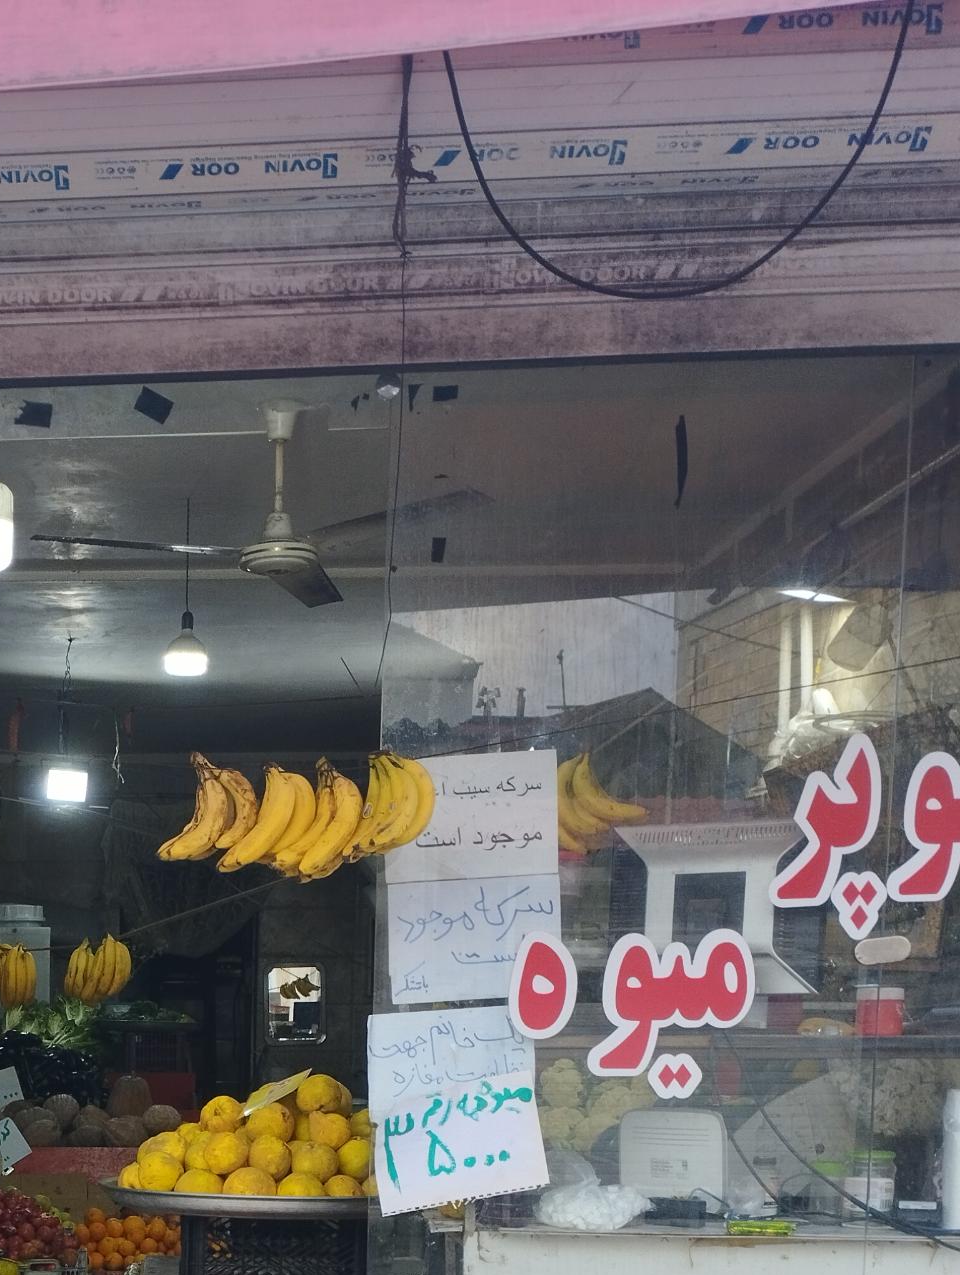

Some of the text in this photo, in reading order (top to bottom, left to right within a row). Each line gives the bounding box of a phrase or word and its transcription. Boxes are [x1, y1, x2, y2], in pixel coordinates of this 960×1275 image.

[190, 152, 338, 179] JOVIN OOR
[548, 139, 629, 166] JOVIN
[496, 775, 543, 797] سرکه
[415, 826, 544, 851] موجود است
[769, 733, 960, 940] وپر
[508, 928, 755, 1099] میوه
